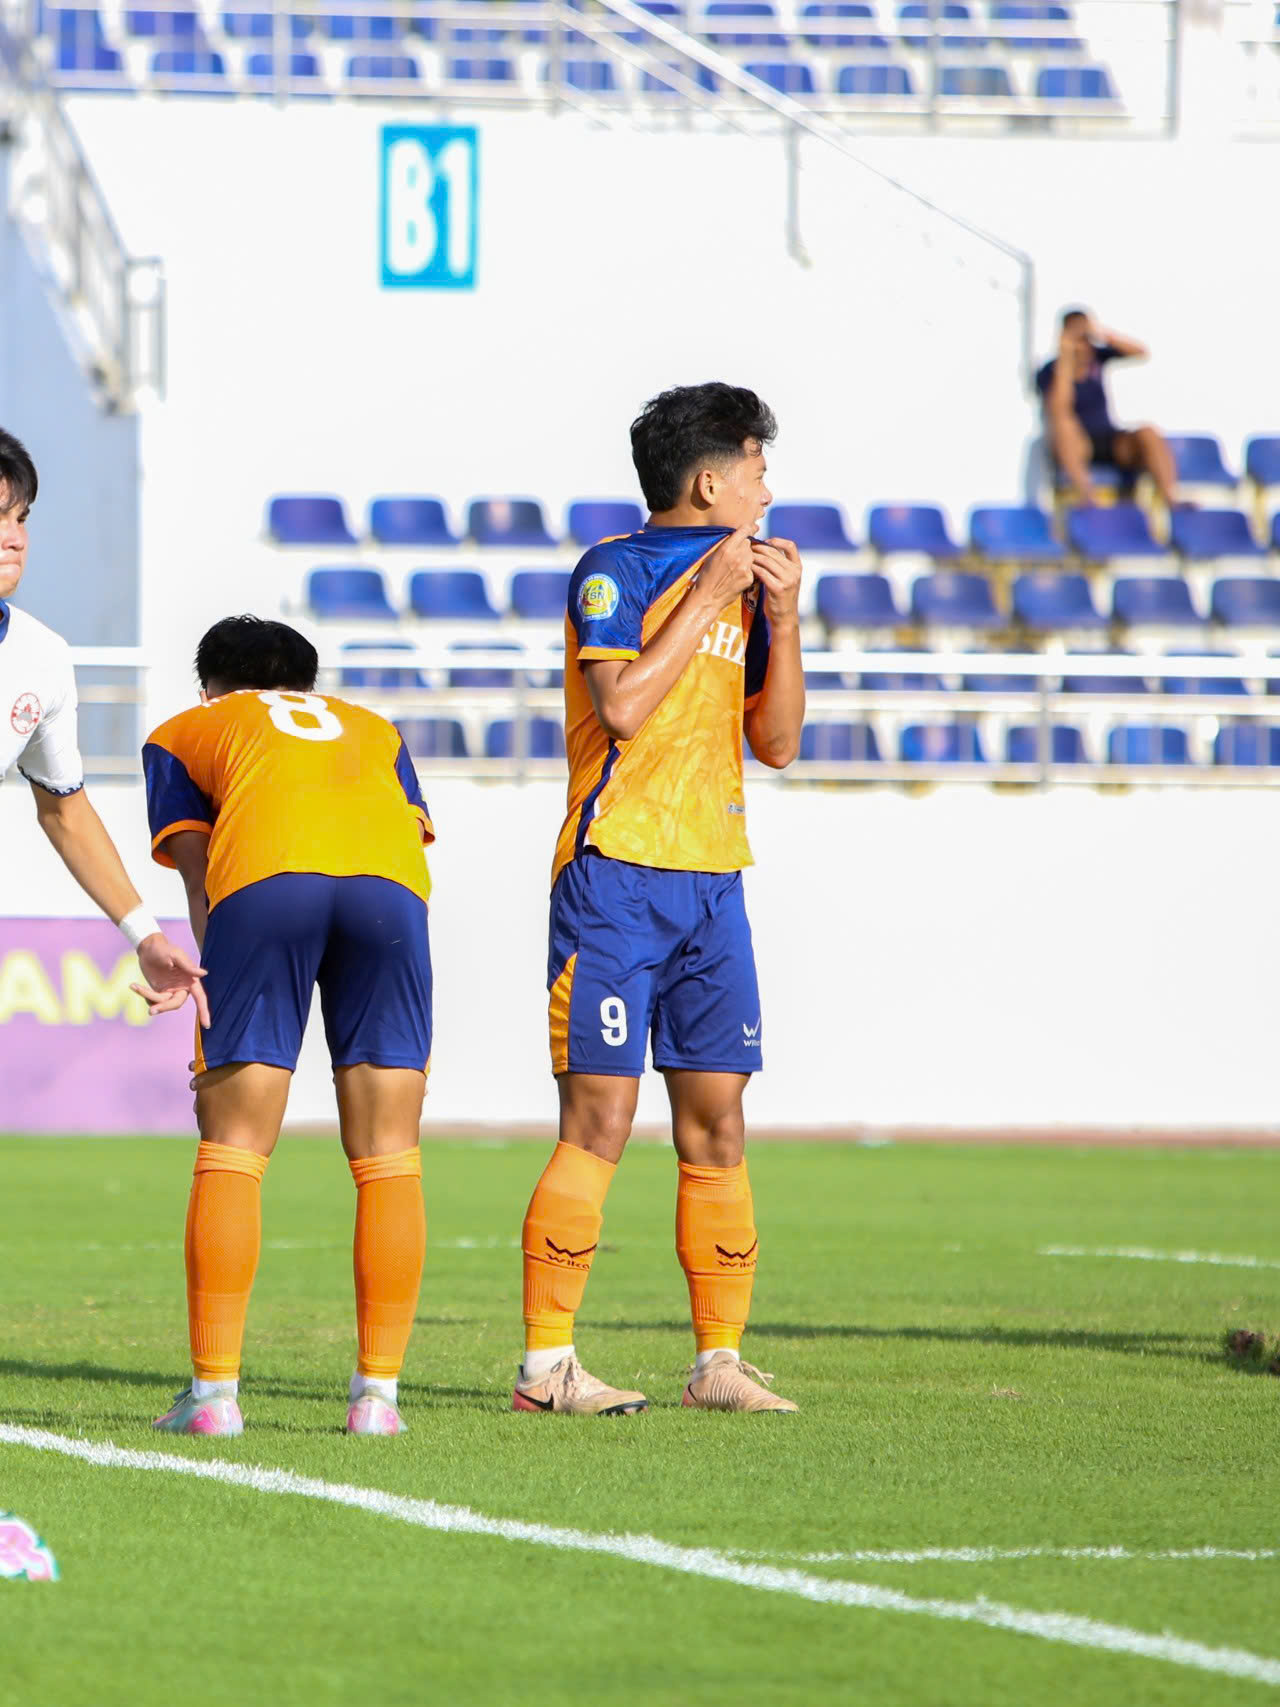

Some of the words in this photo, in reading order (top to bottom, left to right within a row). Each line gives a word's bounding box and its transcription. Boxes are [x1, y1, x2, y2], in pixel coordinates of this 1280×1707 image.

[389, 136, 472, 278] B1
[257, 690, 344, 742] 8
[599, 996, 628, 1047] 9
